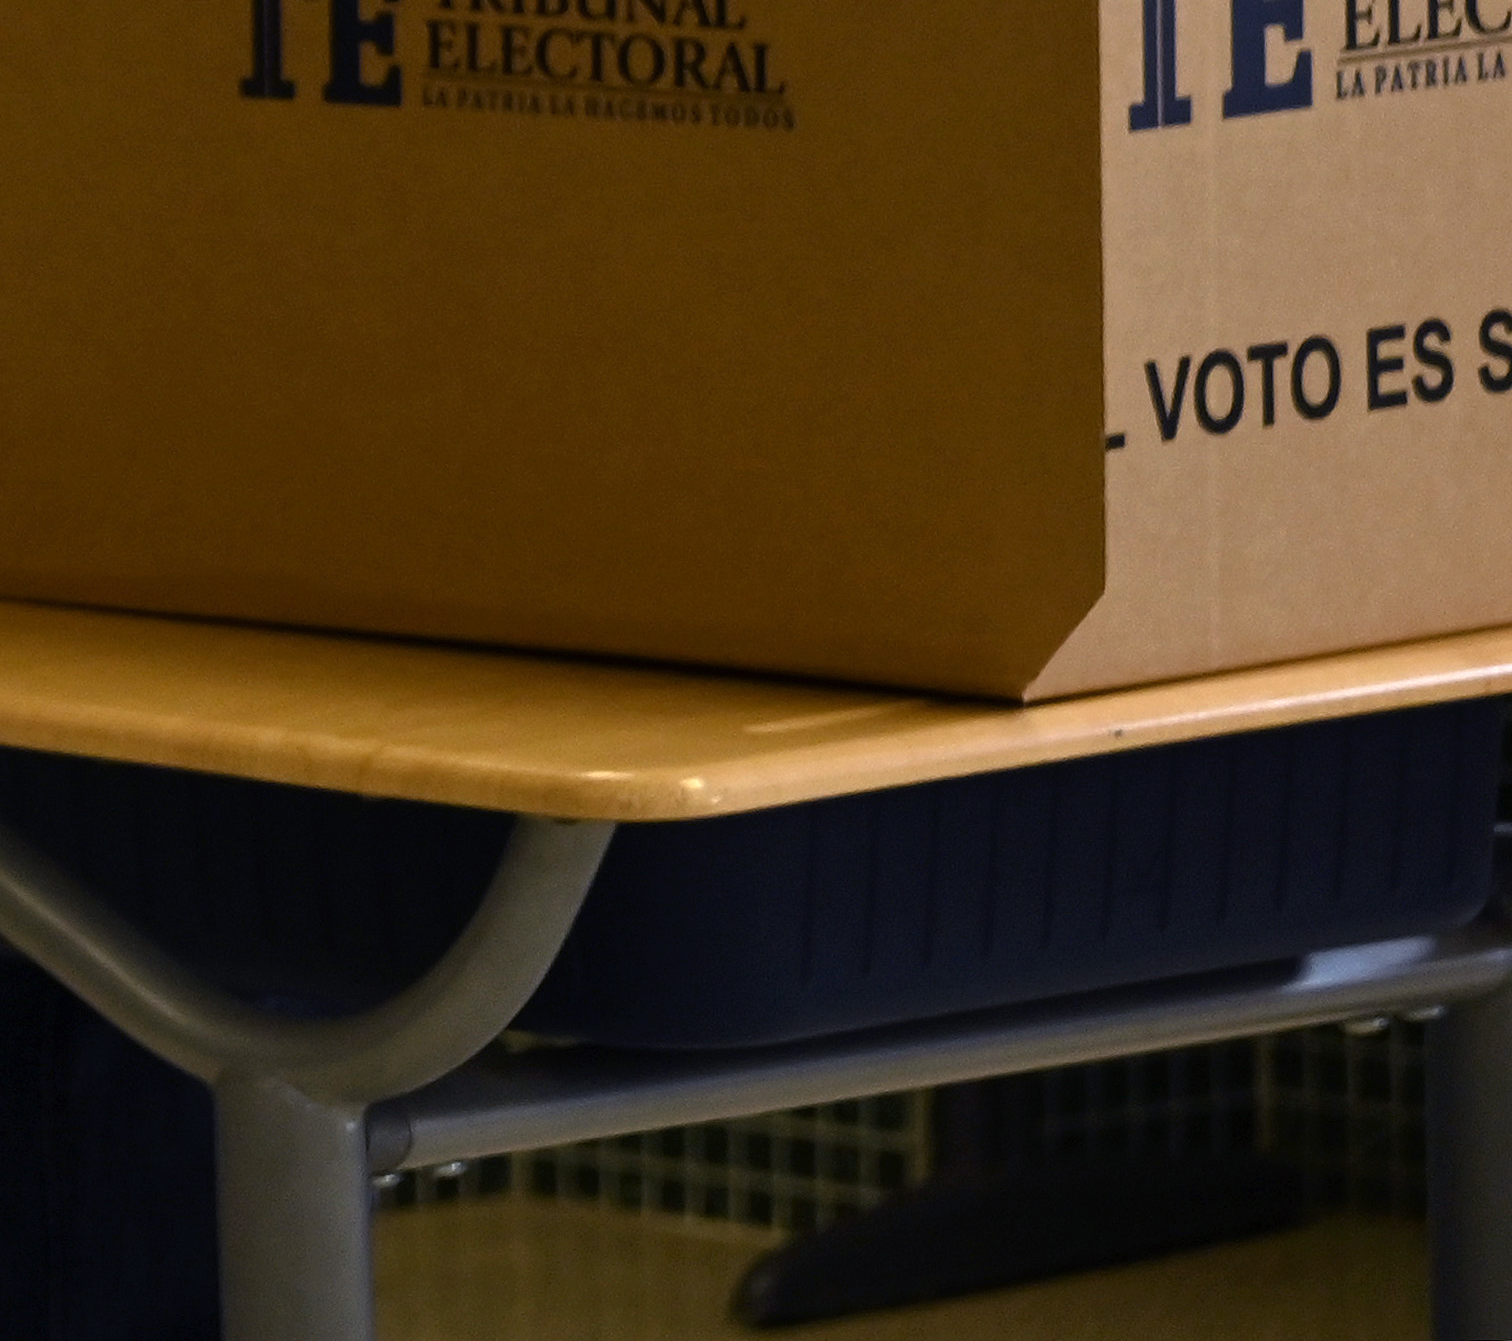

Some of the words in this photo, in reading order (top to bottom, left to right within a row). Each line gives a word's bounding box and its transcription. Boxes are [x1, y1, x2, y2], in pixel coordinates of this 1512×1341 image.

[427, 19, 785, 97] ELECTORAL
[1336, 70, 1366, 100] LA
[1374, 56, 1469, 95] PATRIA
[1477, 51, 1507, 81] LA
[1145, 335, 1342, 442] VOTO
[1366, 318, 1455, 411] ES
